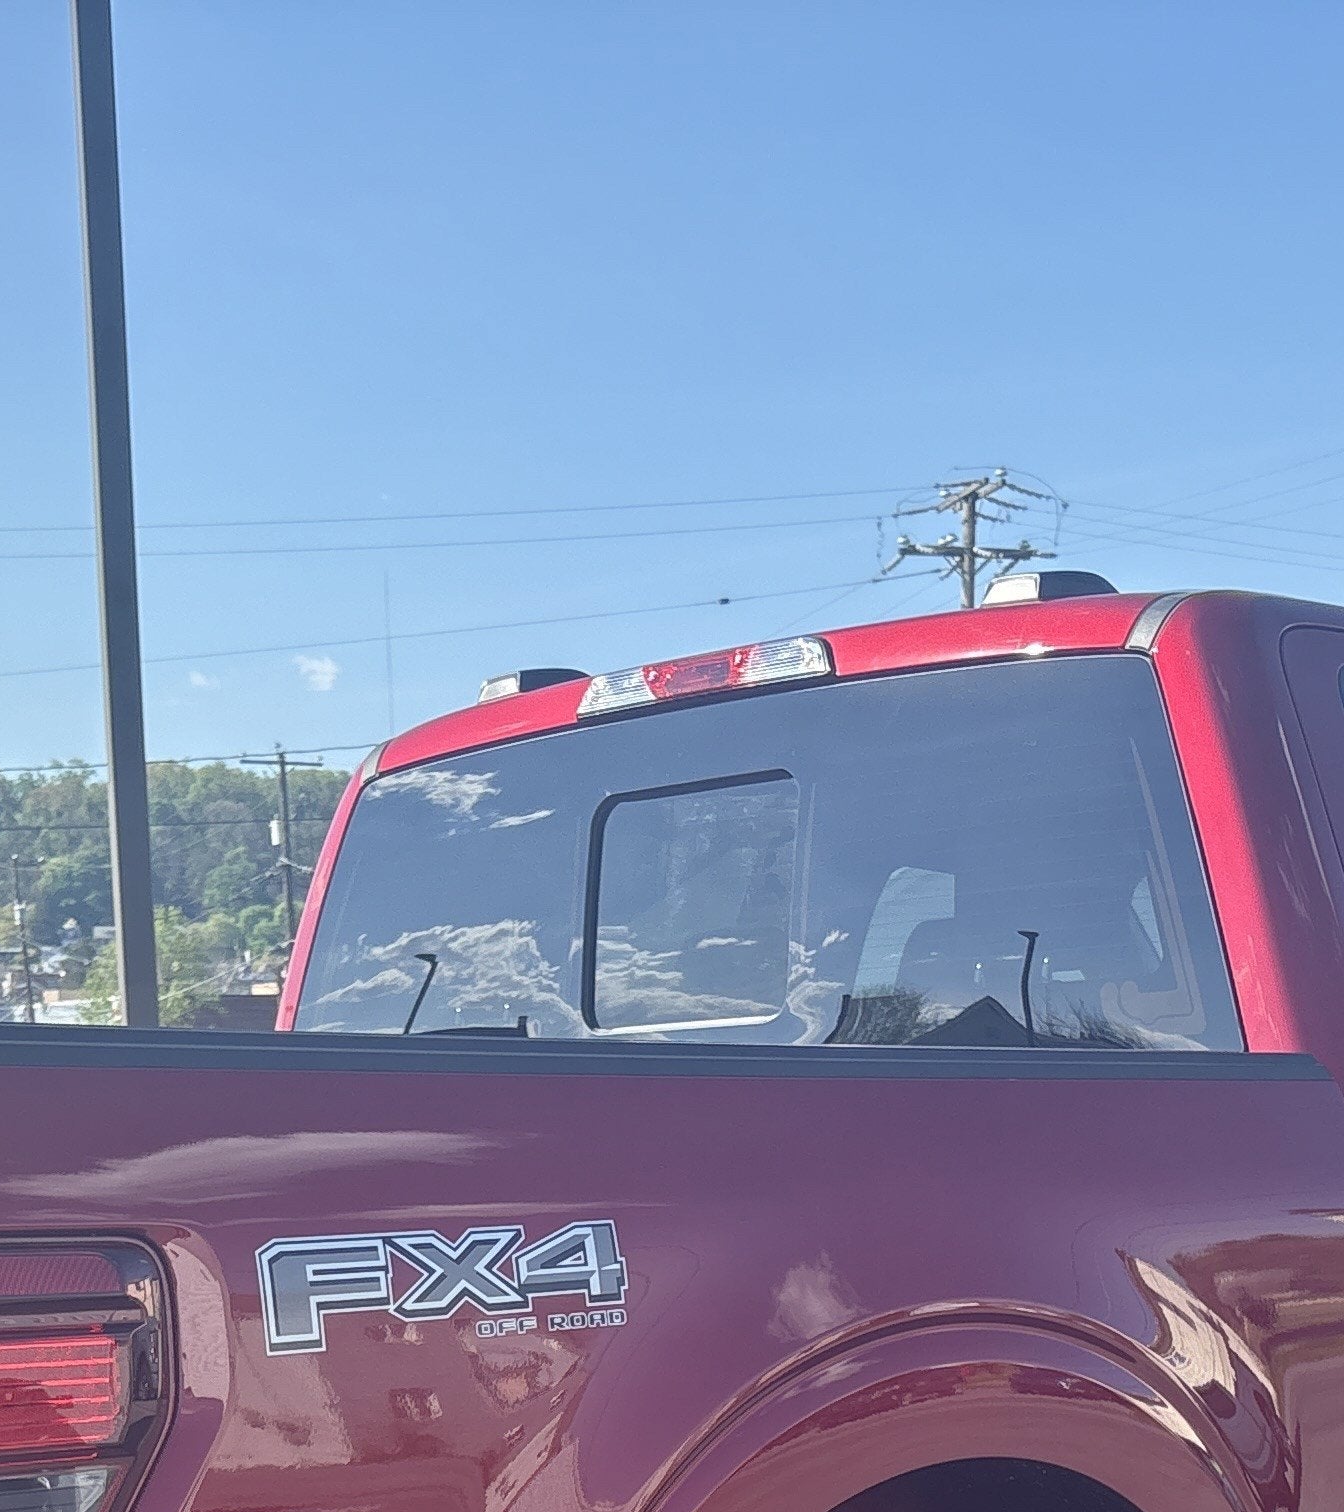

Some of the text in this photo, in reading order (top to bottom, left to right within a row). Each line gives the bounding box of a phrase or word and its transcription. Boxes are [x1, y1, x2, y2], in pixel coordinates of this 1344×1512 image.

[255, 1219, 628, 1356] FX4
[476, 1309, 628, 1338] OFF ROAD
